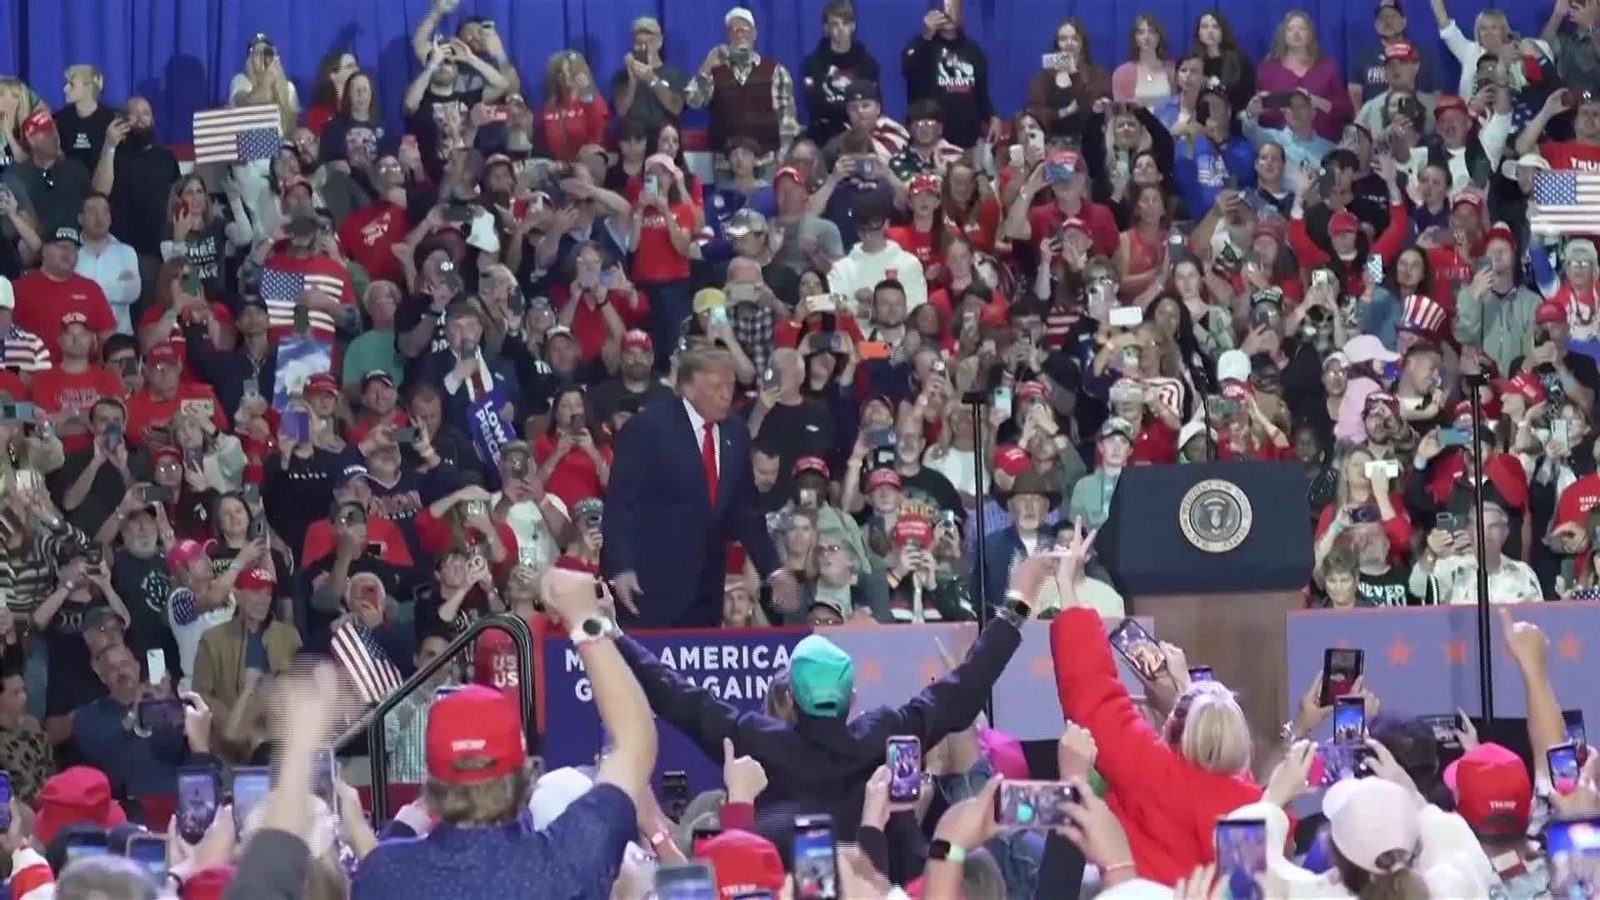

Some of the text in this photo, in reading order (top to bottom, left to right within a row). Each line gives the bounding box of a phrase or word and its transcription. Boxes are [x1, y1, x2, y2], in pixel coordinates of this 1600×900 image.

[1570, 157, 1600, 172] TRU
[484, 401, 507, 443] LOW
[475, 408, 501, 467] PRICE
[660, 645, 791, 670] AMERICA
[686, 676, 774, 700] GAIN
